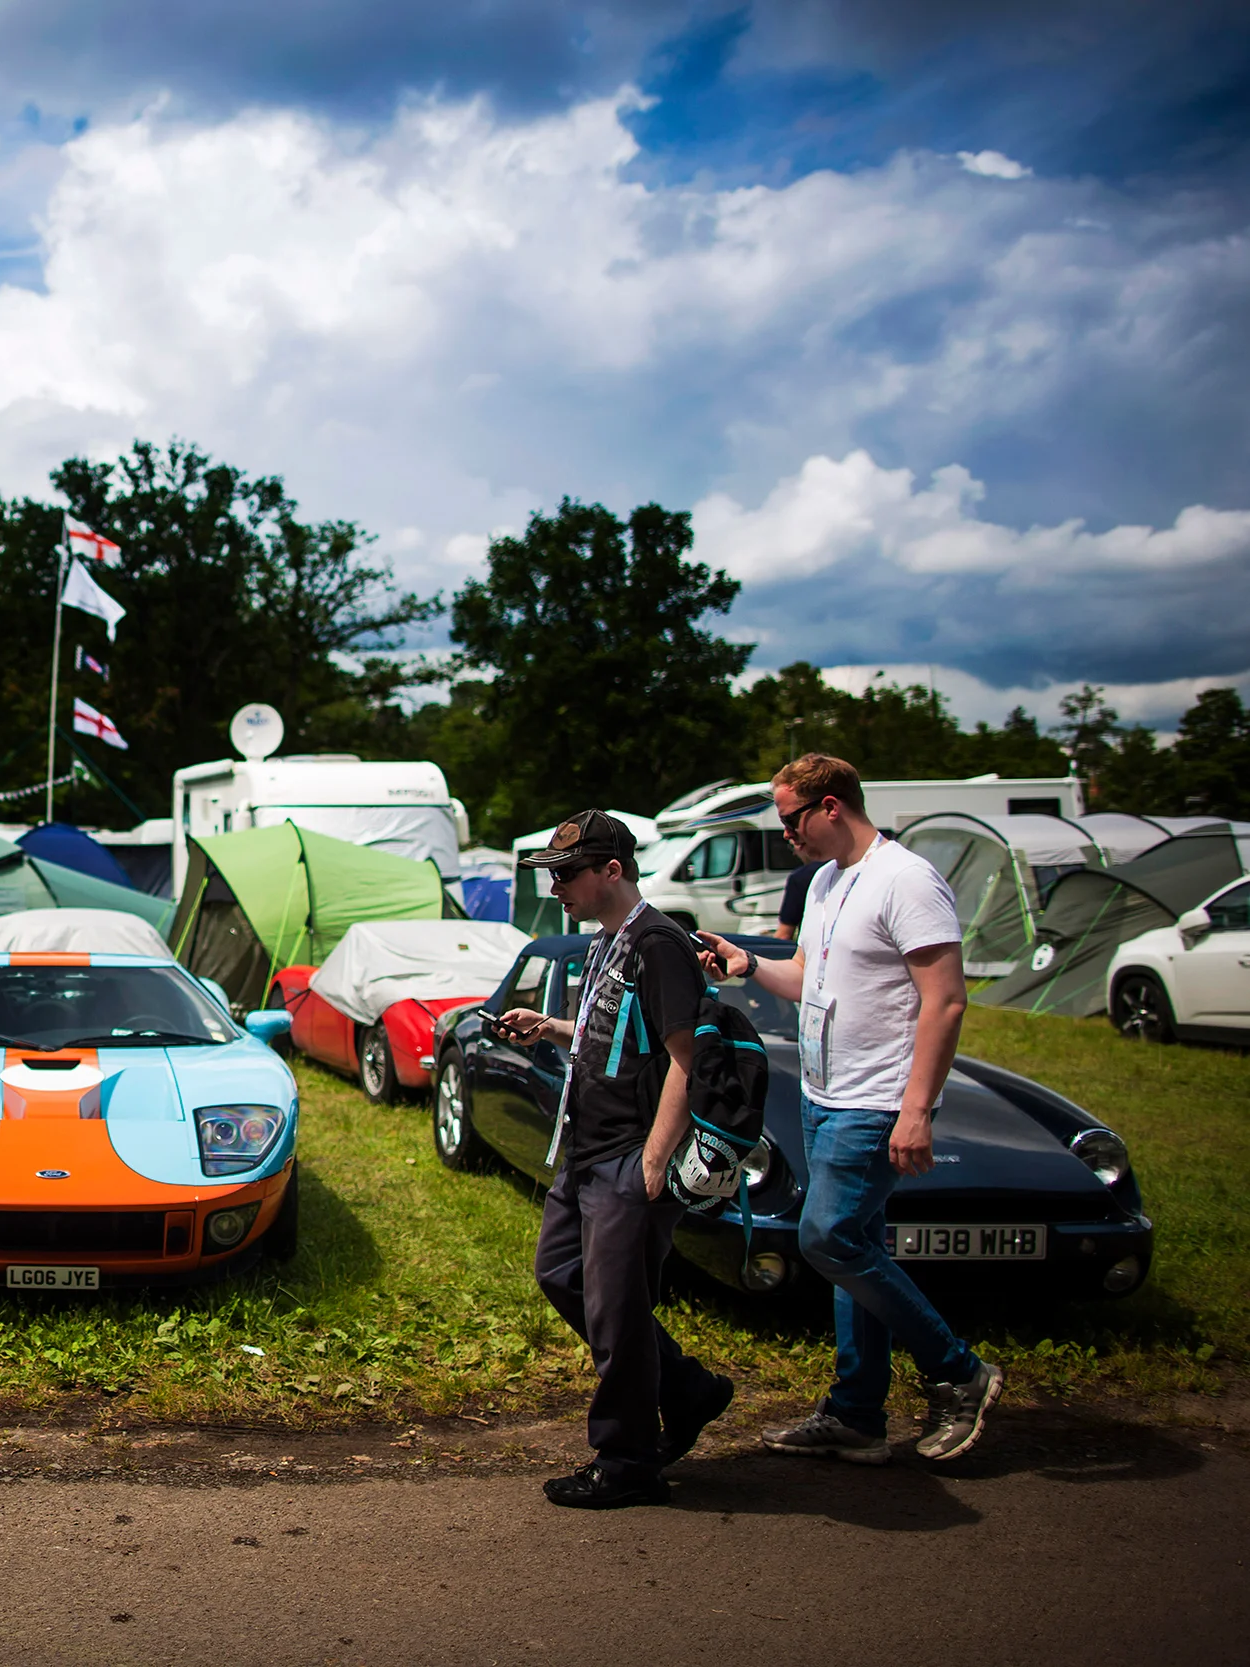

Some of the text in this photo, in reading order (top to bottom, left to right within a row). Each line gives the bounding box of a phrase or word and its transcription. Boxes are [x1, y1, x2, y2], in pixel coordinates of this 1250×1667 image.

[904, 1229, 1036, 1255] J138 WHB
[10, 1270, 95, 1287] LG06 JYE
